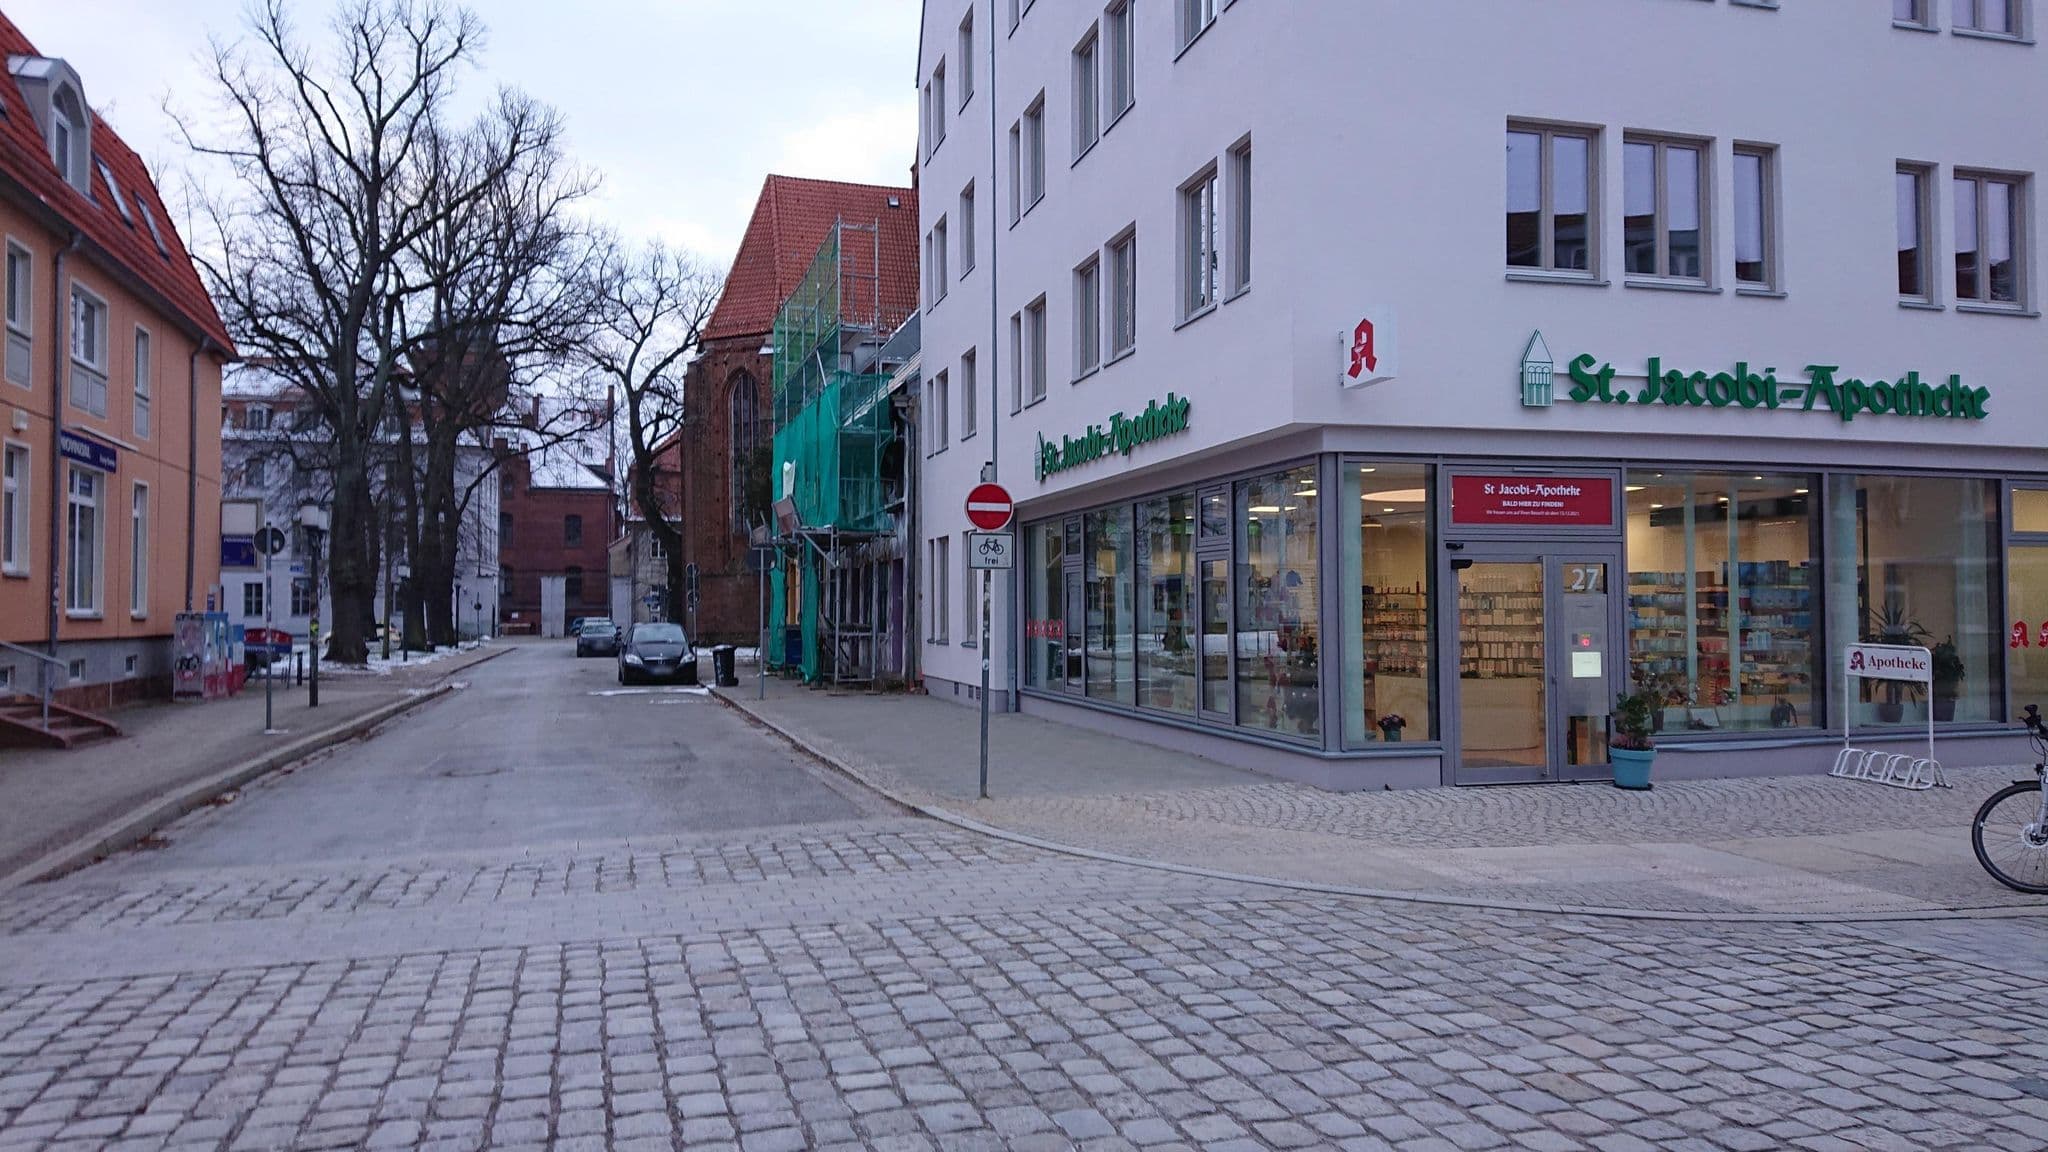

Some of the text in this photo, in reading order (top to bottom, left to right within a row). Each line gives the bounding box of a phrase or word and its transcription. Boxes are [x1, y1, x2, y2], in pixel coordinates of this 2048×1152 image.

[1568, 353, 1991, 422] St. Jacobi-Apotheke
[1043, 392, 1190, 475] St. Jacobi-Apotheke
[1484, 483, 1581, 497] St Jacobi-Apotheke
[984, 556, 999, 565] frei
[1572, 568, 1599, 590] 27
[1868, 655, 1926, 670] Apotheke
